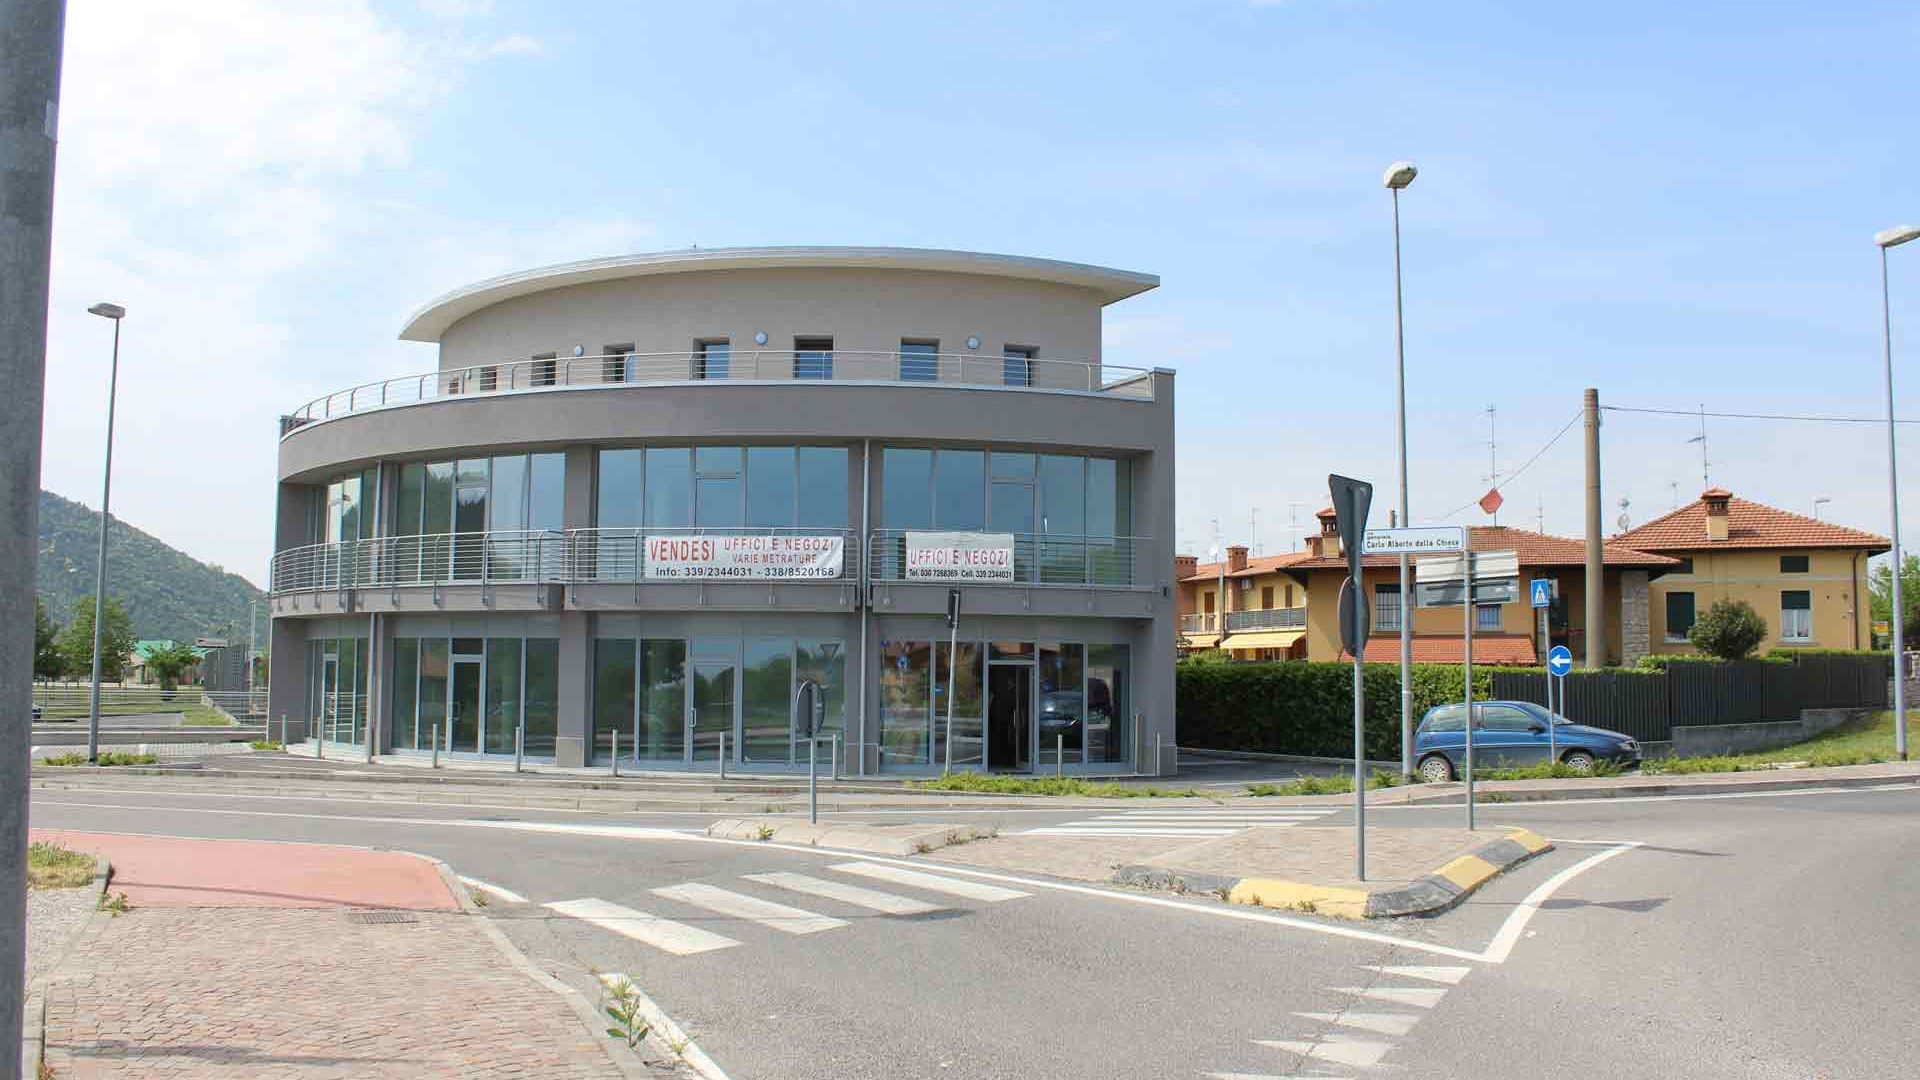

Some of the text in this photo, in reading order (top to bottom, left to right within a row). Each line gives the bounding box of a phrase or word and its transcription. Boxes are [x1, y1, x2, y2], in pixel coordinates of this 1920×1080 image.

[724, 538, 834, 550] UFFICI E NEGOZI
[1367, 541, 1385, 549] Carlo
[650, 540, 716, 562] VENDESI
[732, 554, 818, 564] VARIE METRATURE
[910, 549, 1009, 566] UFFICI E NEGOZI
[656, 566, 681, 577] Info:
[685, 566, 752, 577] 339/2344031
[764, 566, 835, 577] 338/8520168
[920, 568, 932, 577] 030
[976, 569, 987, 578] 339
